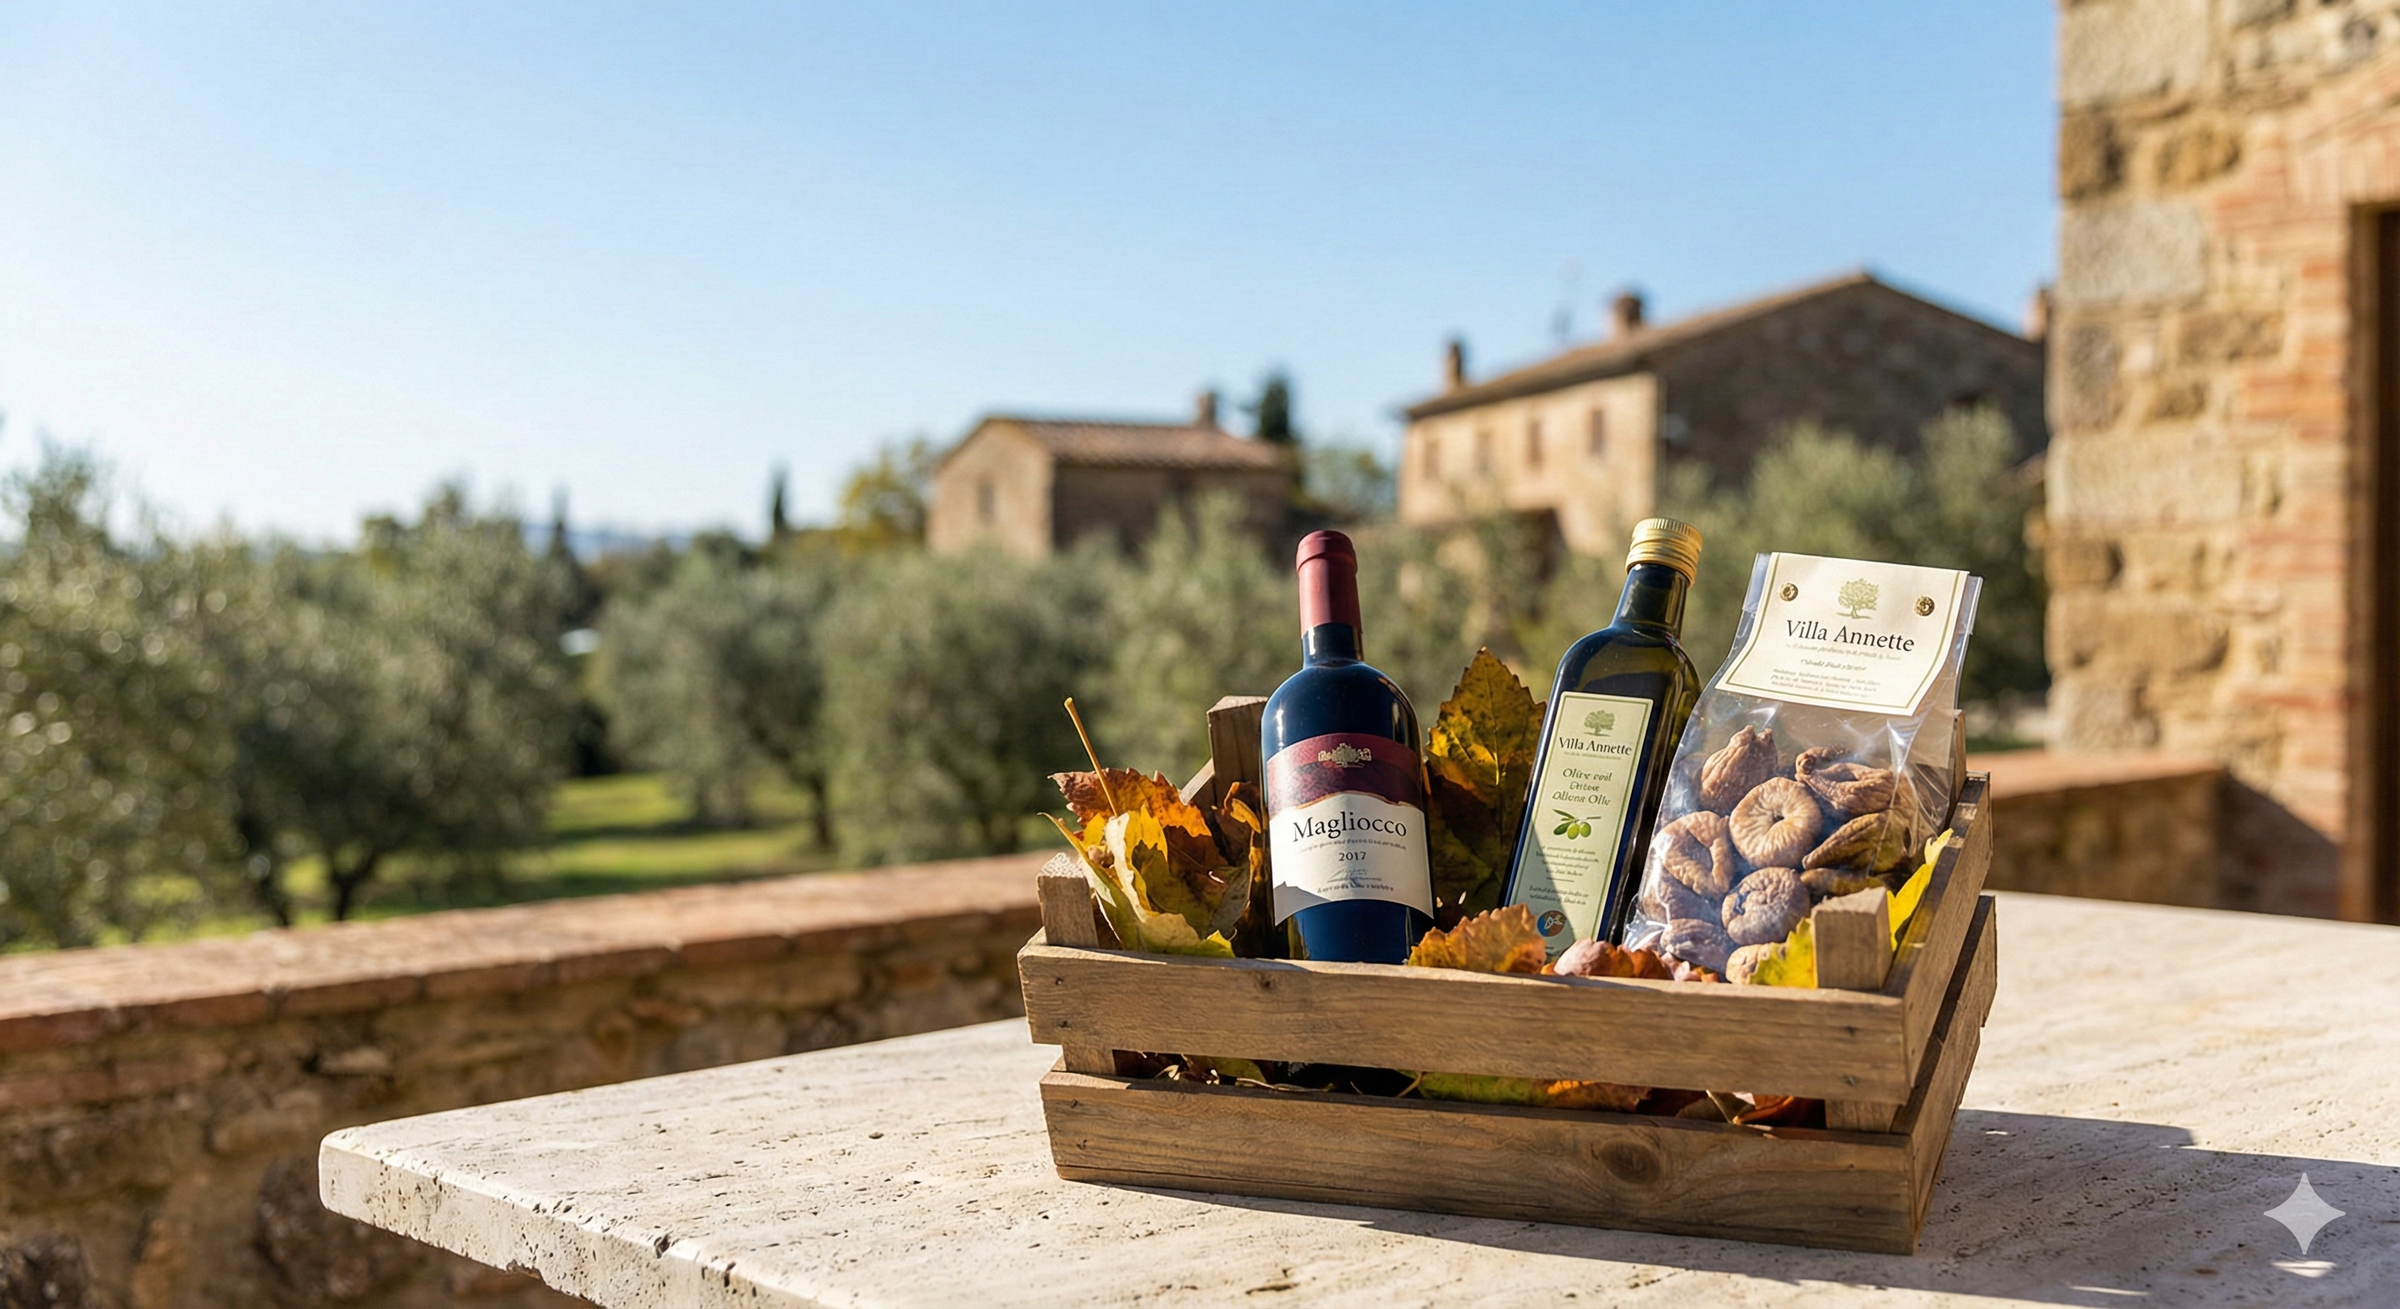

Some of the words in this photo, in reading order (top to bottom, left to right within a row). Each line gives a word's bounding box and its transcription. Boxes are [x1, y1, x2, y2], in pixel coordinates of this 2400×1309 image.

[1786, 619, 1828, 641] Villa
[1833, 625, 1915, 652] Annette
[1559, 737, 1584, 750] Villa
[1586, 740, 1632, 756] Annette
[1292, 811, 1407, 843] Magliocco
[1338, 851, 1367, 862] 2017
